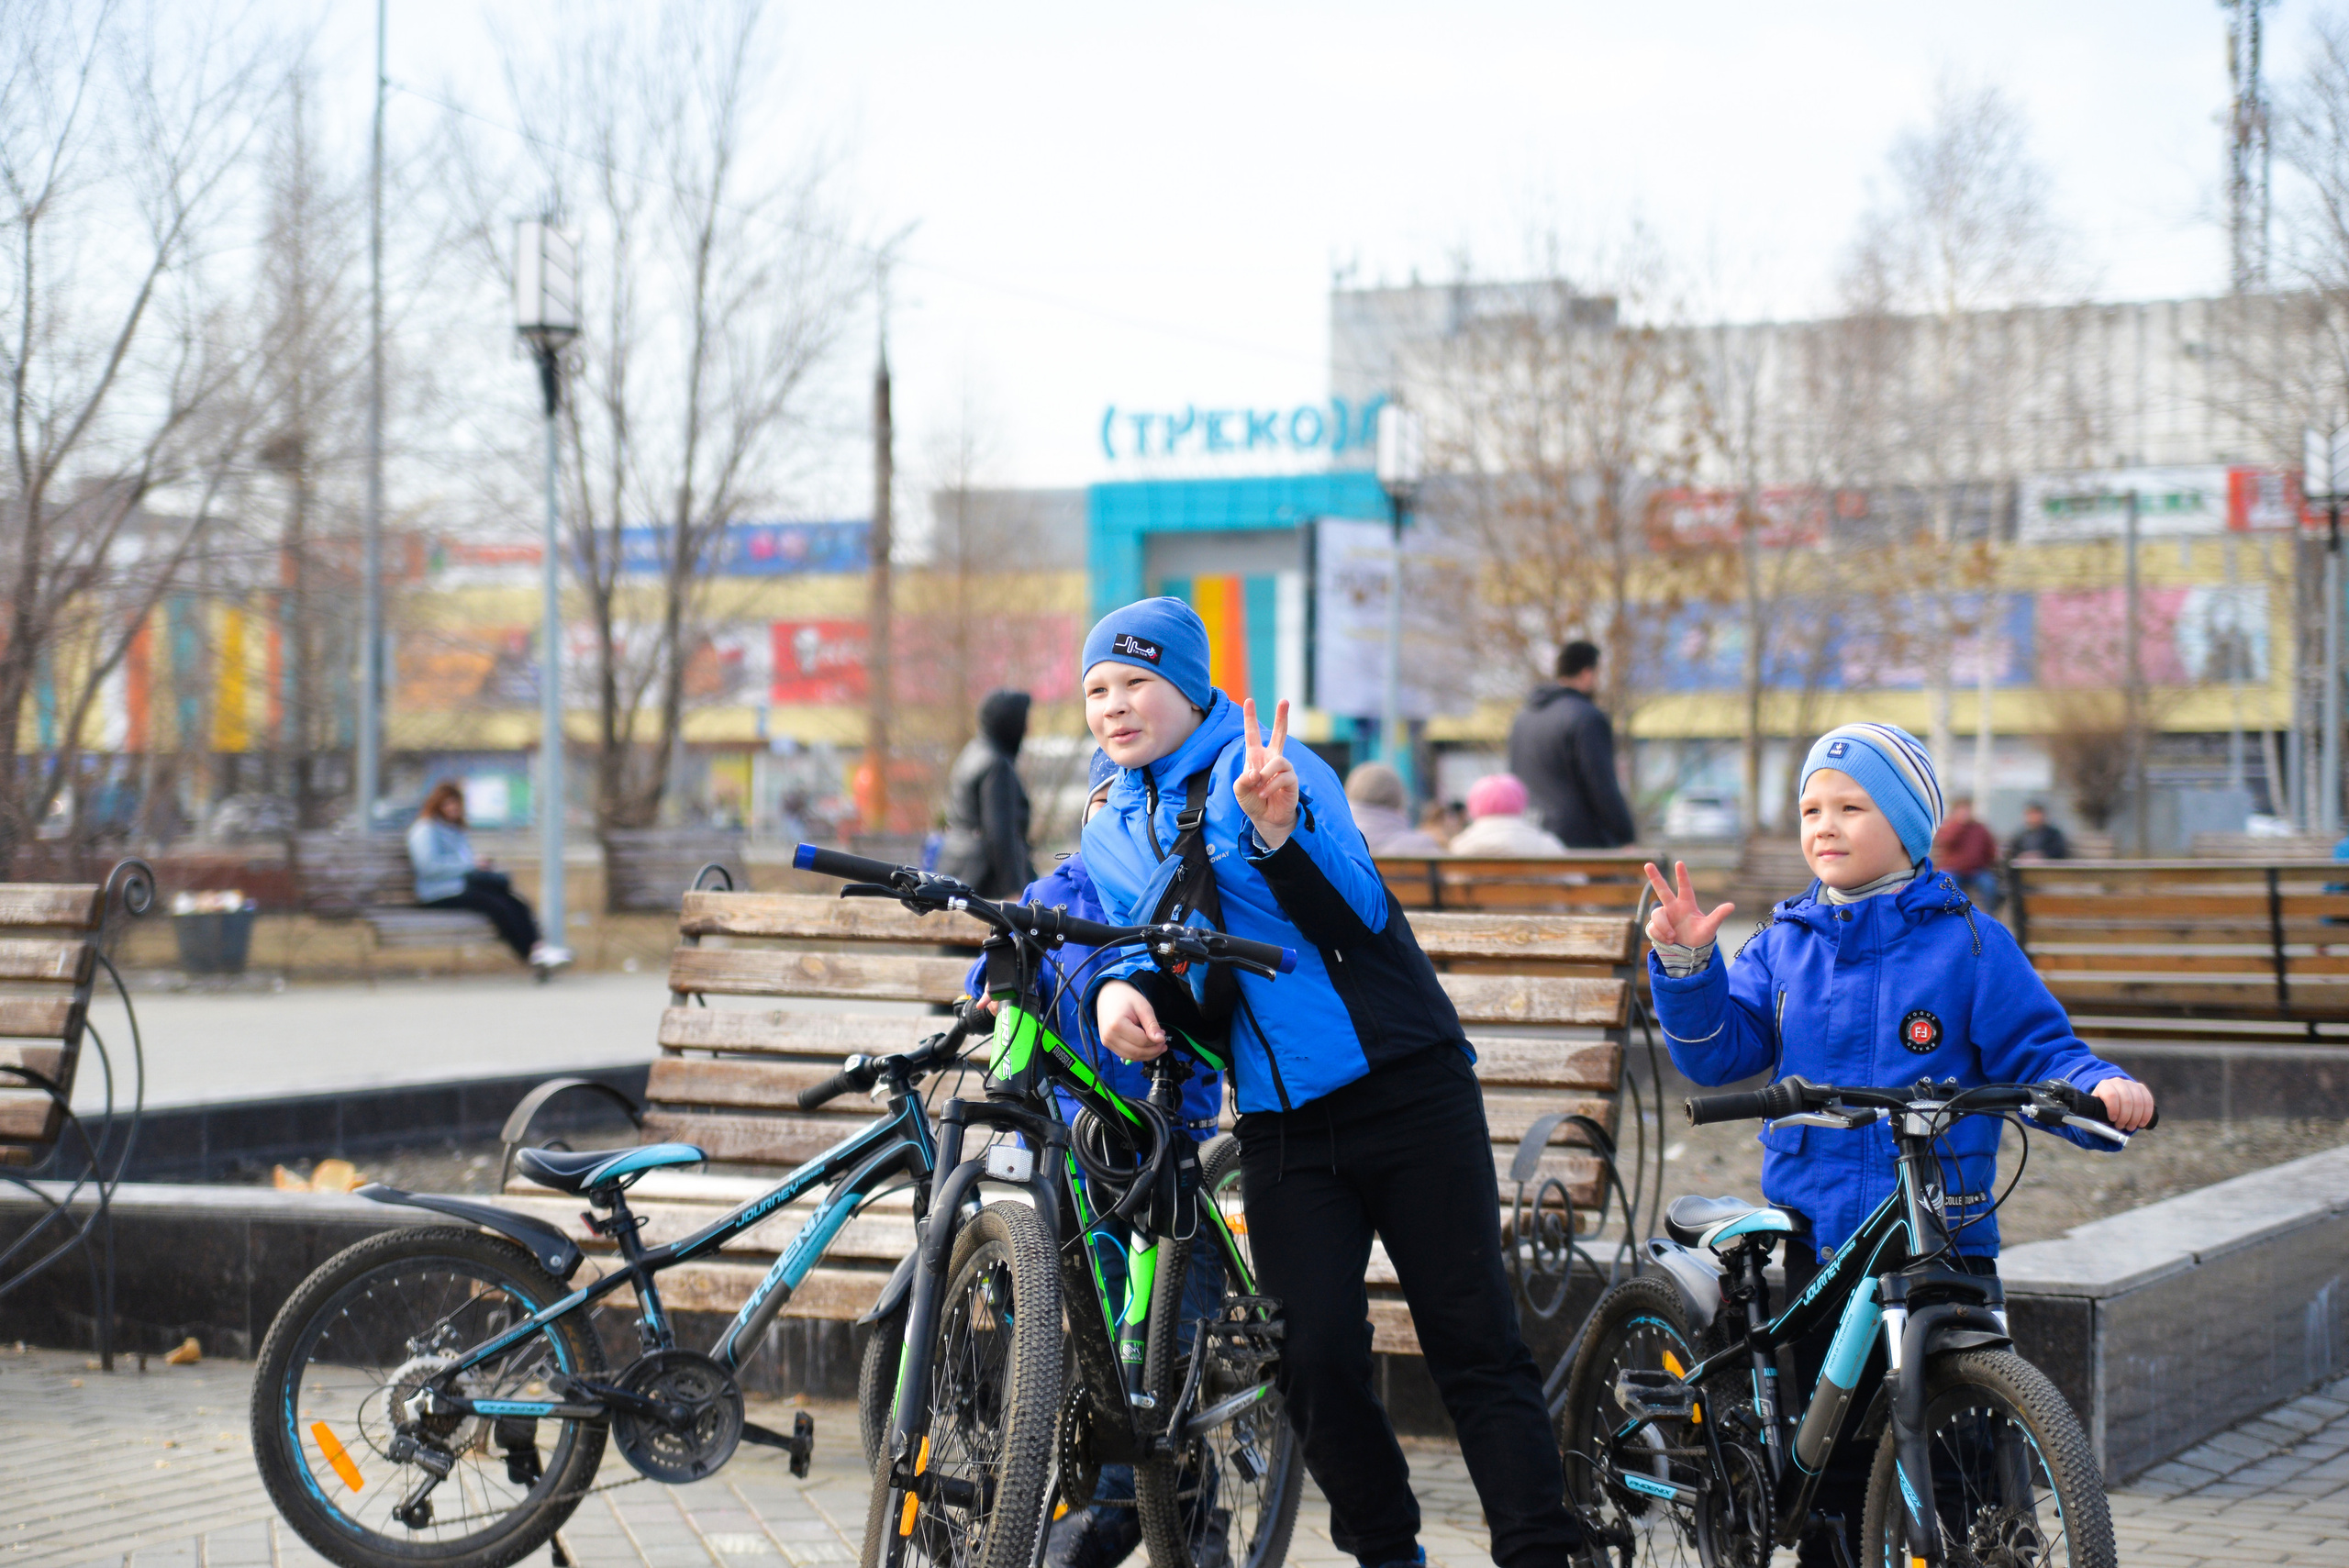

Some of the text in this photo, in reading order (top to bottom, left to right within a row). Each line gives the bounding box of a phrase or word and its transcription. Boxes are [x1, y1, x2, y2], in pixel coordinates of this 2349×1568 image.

[1907, 1011, 1936, 1021] VOGUE
[1052, 1045, 1074, 1069] RUSSIA
[736, 1181, 799, 1229] JOURNEY
[738, 1197, 831, 1326] PHOENIX
[1802, 1256, 1841, 1307] JOURNEY
[1629, 1480, 1672, 1496] PHOENIX
